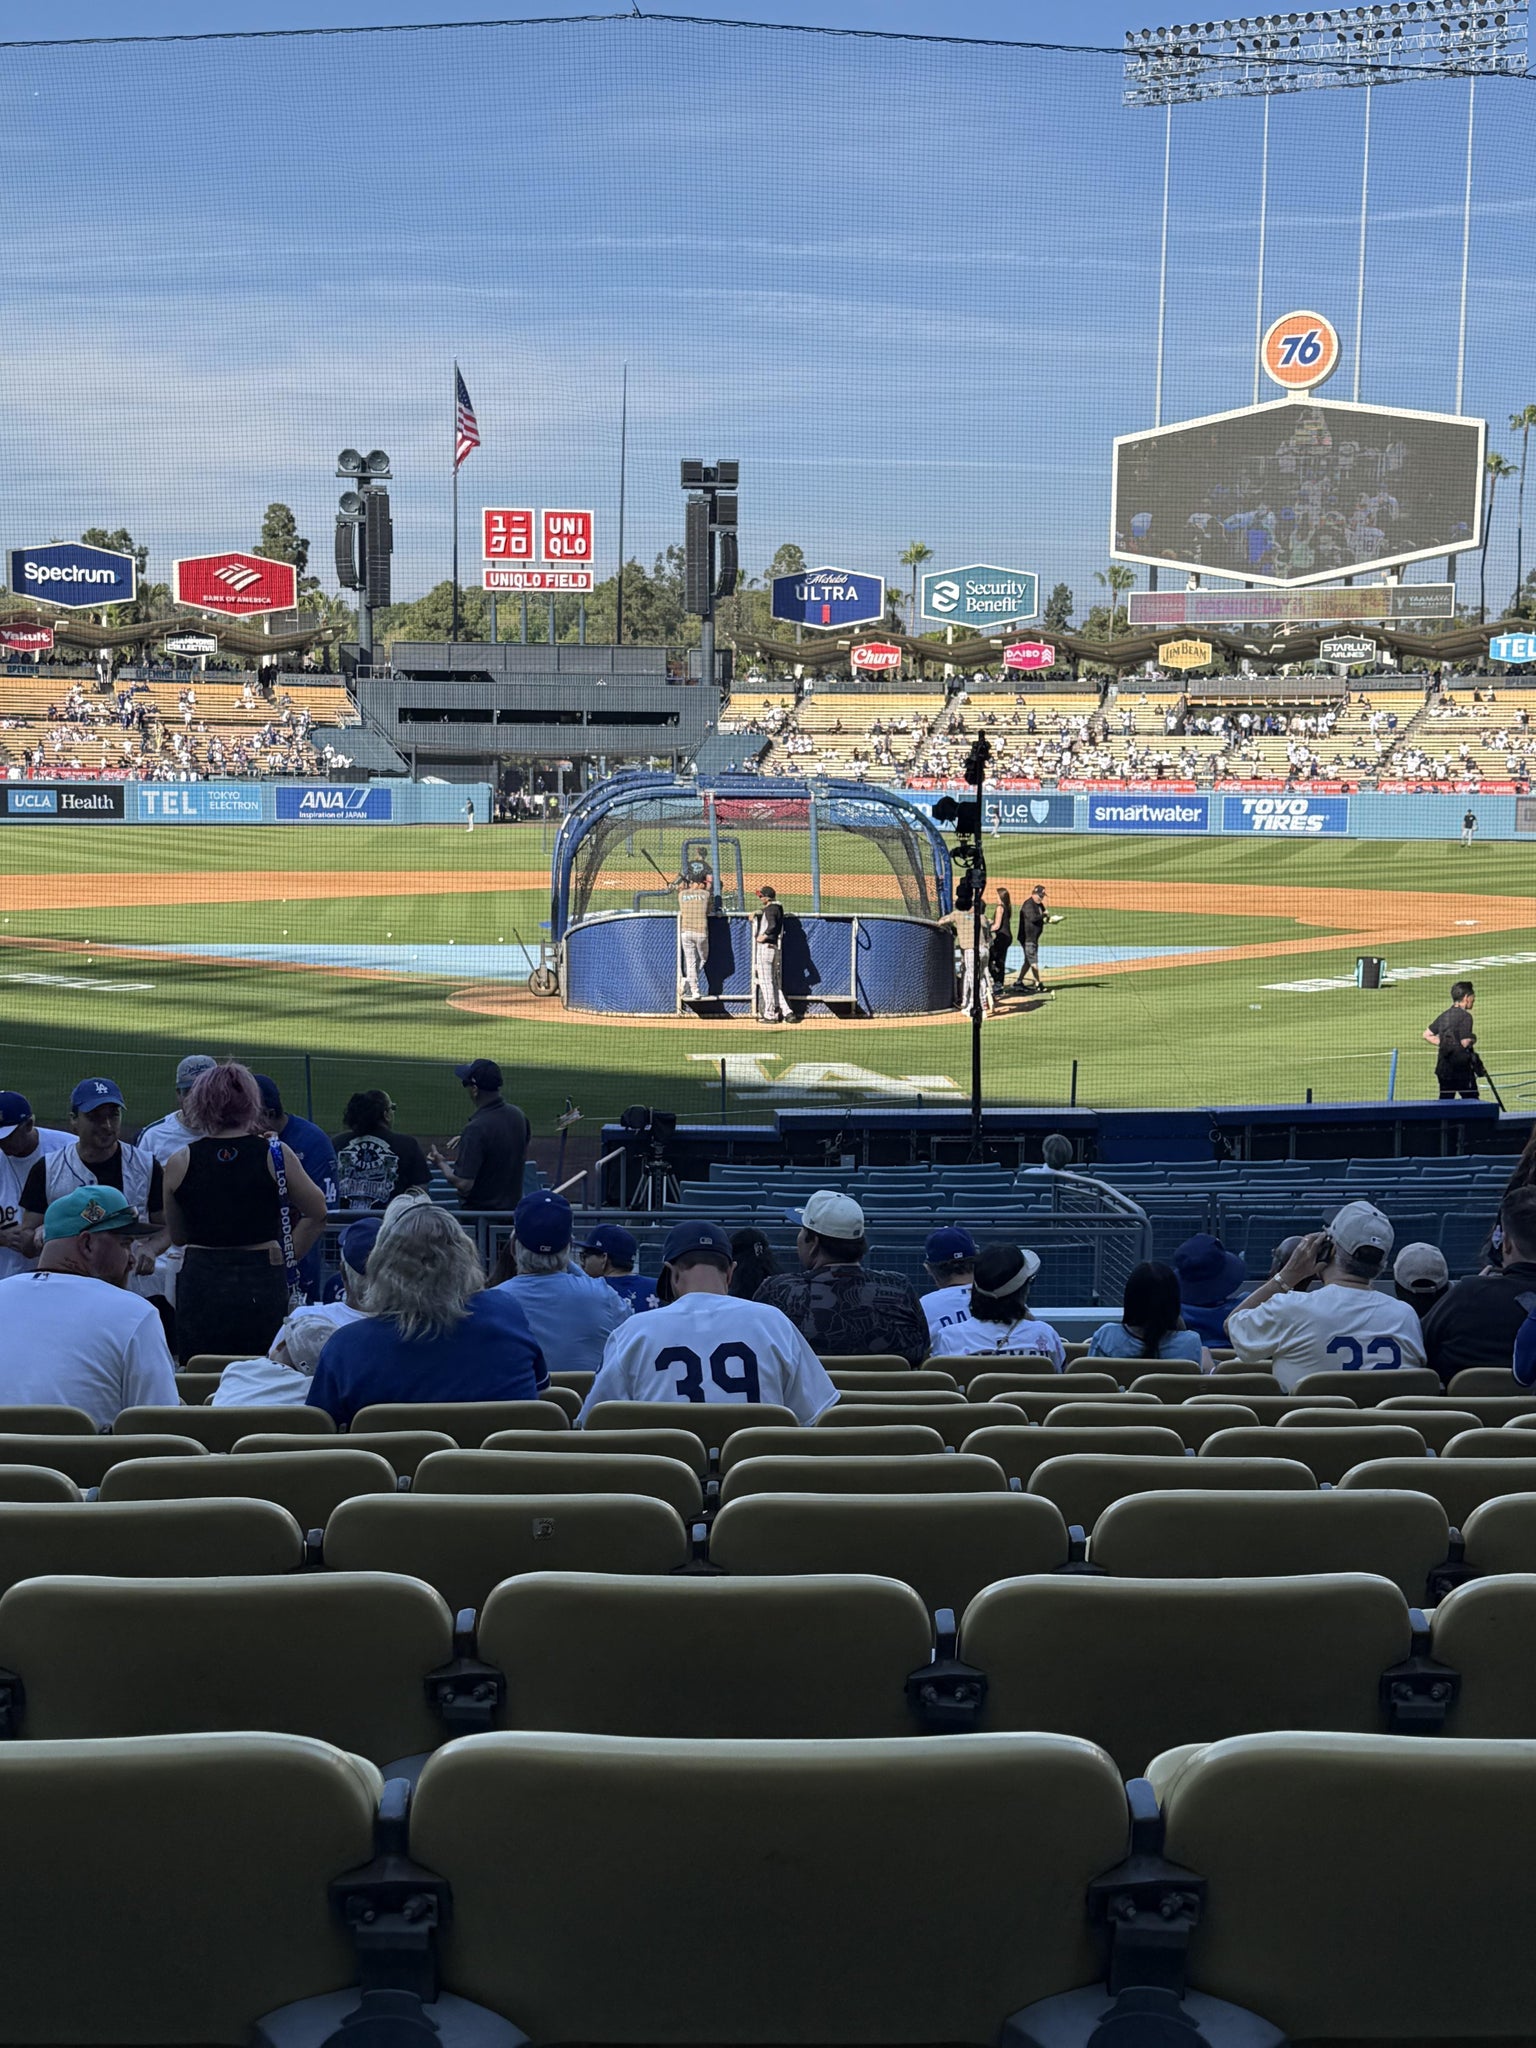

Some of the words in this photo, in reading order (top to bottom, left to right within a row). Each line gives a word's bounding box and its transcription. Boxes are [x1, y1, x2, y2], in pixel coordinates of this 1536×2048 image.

[1278, 329, 1322, 367] 76
[549, 518, 583, 534] UNI
[549, 538, 586, 556] QLO
[24, 562, 116, 585] Spectrum
[490, 572, 541, 589] UNIQLO
[545, 574, 587, 588] FIELD
[795, 586, 859, 601] ULTRA
[965, 580, 1027, 599] Security
[236, 596, 271, 604] AMERICA
[965, 597, 1018, 612] Benefit
[1, 630, 51, 643] Yakult
[1006, 649, 1040, 658] DAISO
[1163, 647, 1181, 663] JIM
[1181, 643, 1208, 660] BEAM
[1323, 644, 1372, 652] STARLUX
[1496, 638, 1536, 657] TEL
[853, 648, 899, 665] Churu
[14, 794, 51, 808] UCLA
[61, 794, 115, 811] Health
[142, 791, 198, 815] TEL
[209, 791, 241, 800] TOKYO
[299, 791, 345, 809] ANA
[209, 801, 260, 811] ELECTRON
[985, 800, 1029, 818] blue
[1094, 804, 1202, 823] smartwater
[1242, 799, 1309, 814] TOYO
[299, 811, 336, 820] Inspiration
[345, 812, 368, 820] JAPAN
[1252, 814, 1323, 831] TIRES
[277, 1170, 288, 1196] LOS
[280, 1206, 297, 1268] DODGERS
[1326, 1336, 1402, 1370] 32
[655, 1341, 760, 1404] 39
